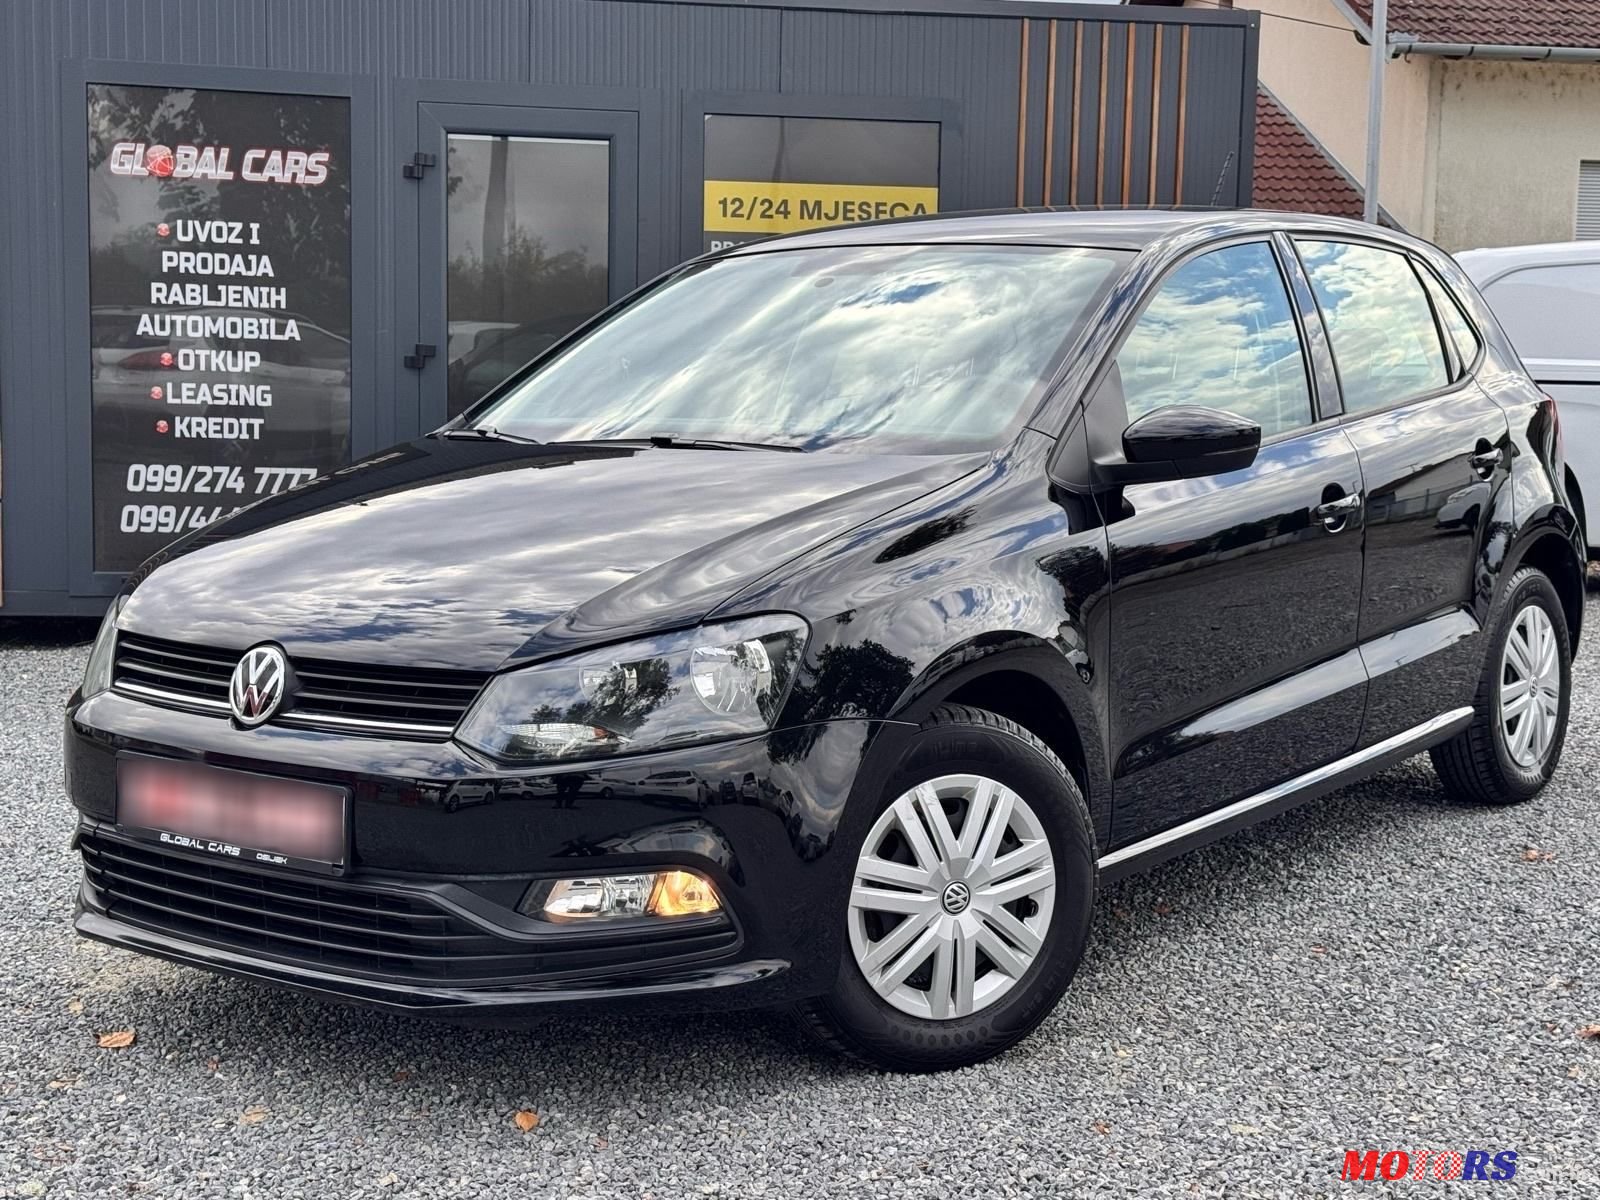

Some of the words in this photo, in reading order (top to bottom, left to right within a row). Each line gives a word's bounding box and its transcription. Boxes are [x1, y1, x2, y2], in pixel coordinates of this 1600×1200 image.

[109, 142, 234, 180] GLOBAL
[241, 149, 330, 184] CARS
[718, 196, 791, 220] 12/24
[176, 219, 243, 244] UVOZ
[249, 222, 260, 245] I
[161, 251, 275, 277] PRODAJA
[150, 282, 287, 309] RABLJENIH
[136, 313, 301, 341] AUTOMOBILA
[177, 349, 261, 373] OTKUP
[166, 382, 273, 407] LEASING
[174, 416, 265, 440] KREDIT
[126, 464, 245, 494] 099/274
[254, 467, 318, 495] 7777
[160, 832, 205, 850] GLOBAL
[207, 842, 241, 857] CARS
